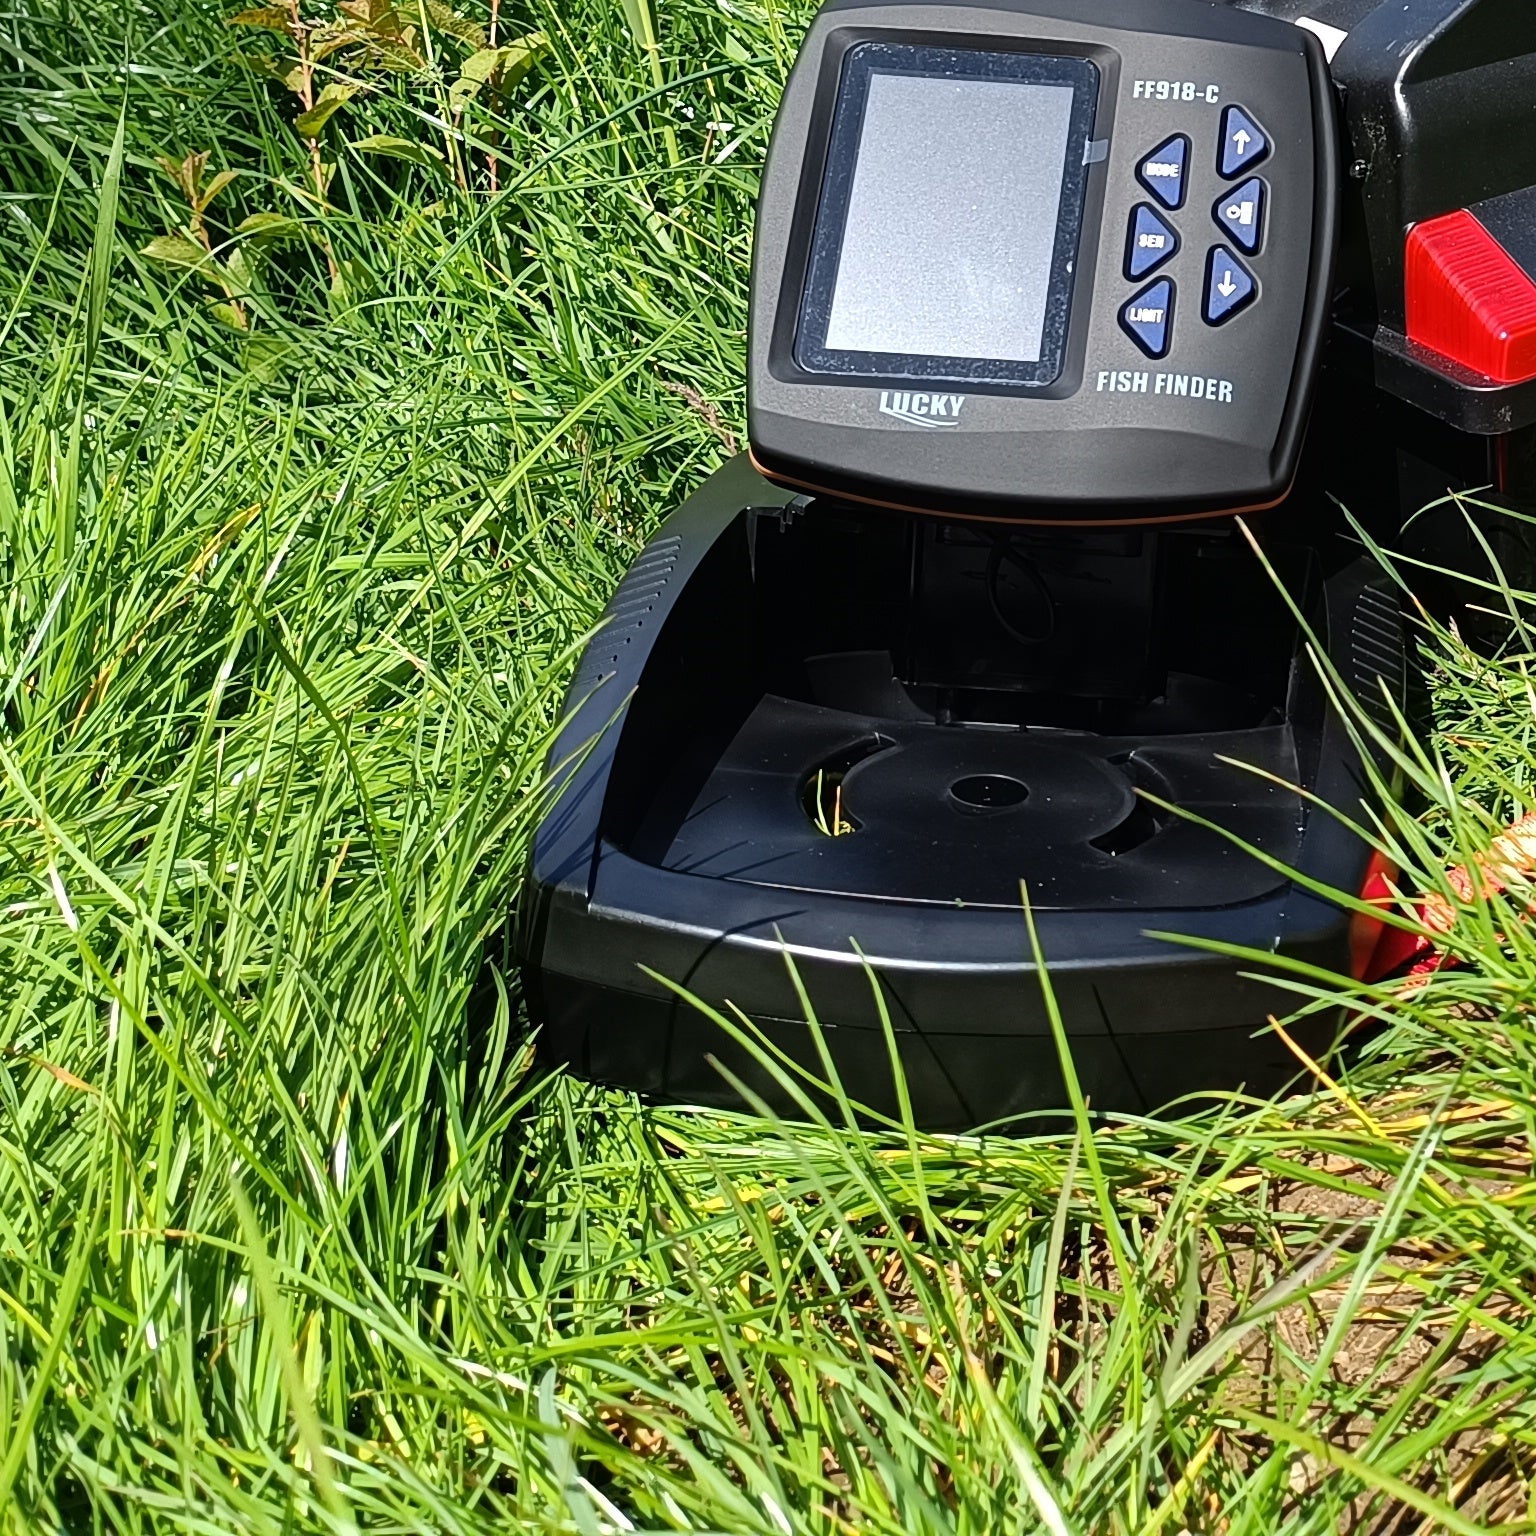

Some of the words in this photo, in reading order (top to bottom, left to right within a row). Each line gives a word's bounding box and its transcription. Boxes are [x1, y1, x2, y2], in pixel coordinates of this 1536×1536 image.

[1132, 80, 1220, 104] FF918-C
[1096, 371, 1149, 393] FISH
[1154, 373, 1233, 403] FINDER
[879, 391, 966, 417] LUCKY
